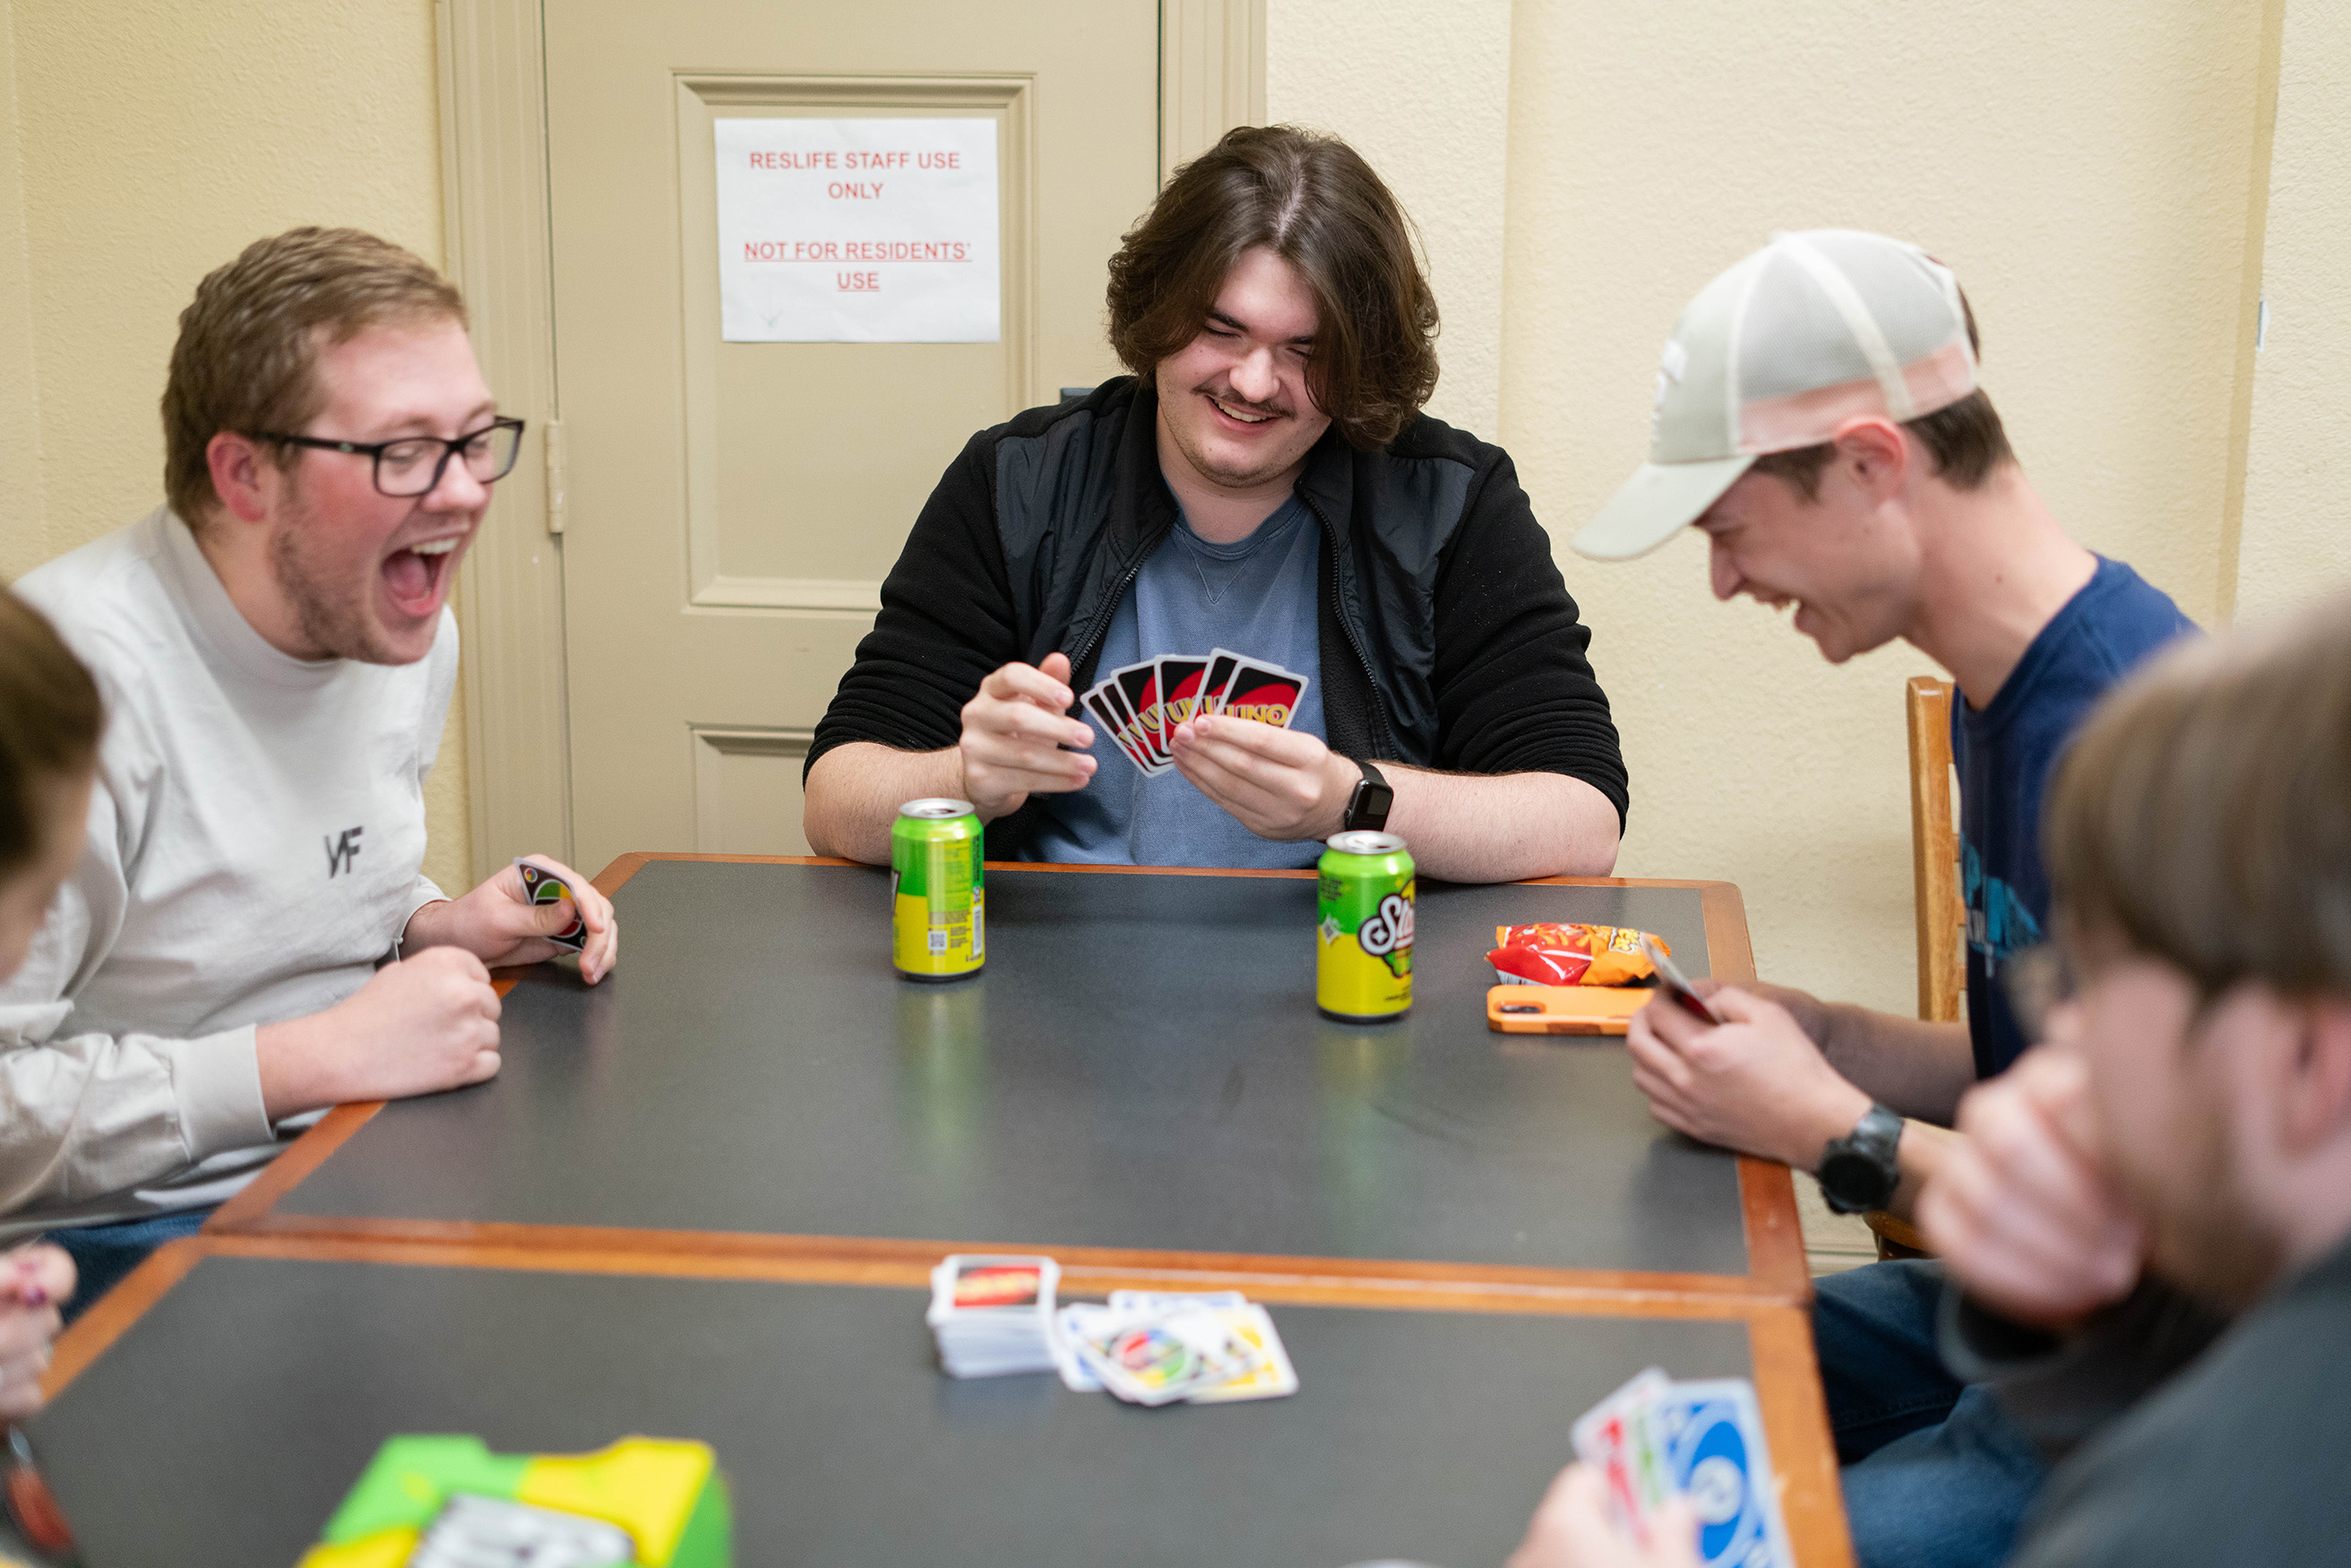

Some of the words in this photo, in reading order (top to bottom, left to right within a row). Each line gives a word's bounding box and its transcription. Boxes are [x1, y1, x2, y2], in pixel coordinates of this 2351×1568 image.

[750, 152, 838, 169] RESLIFE
[845, 151, 909, 168] STAFF
[917, 151, 960, 169] USE
[828, 182, 883, 199] ONLY
[745, 241, 787, 261] NOT
[795, 242, 839, 261] FOR
[837, 271, 880, 291] USE
